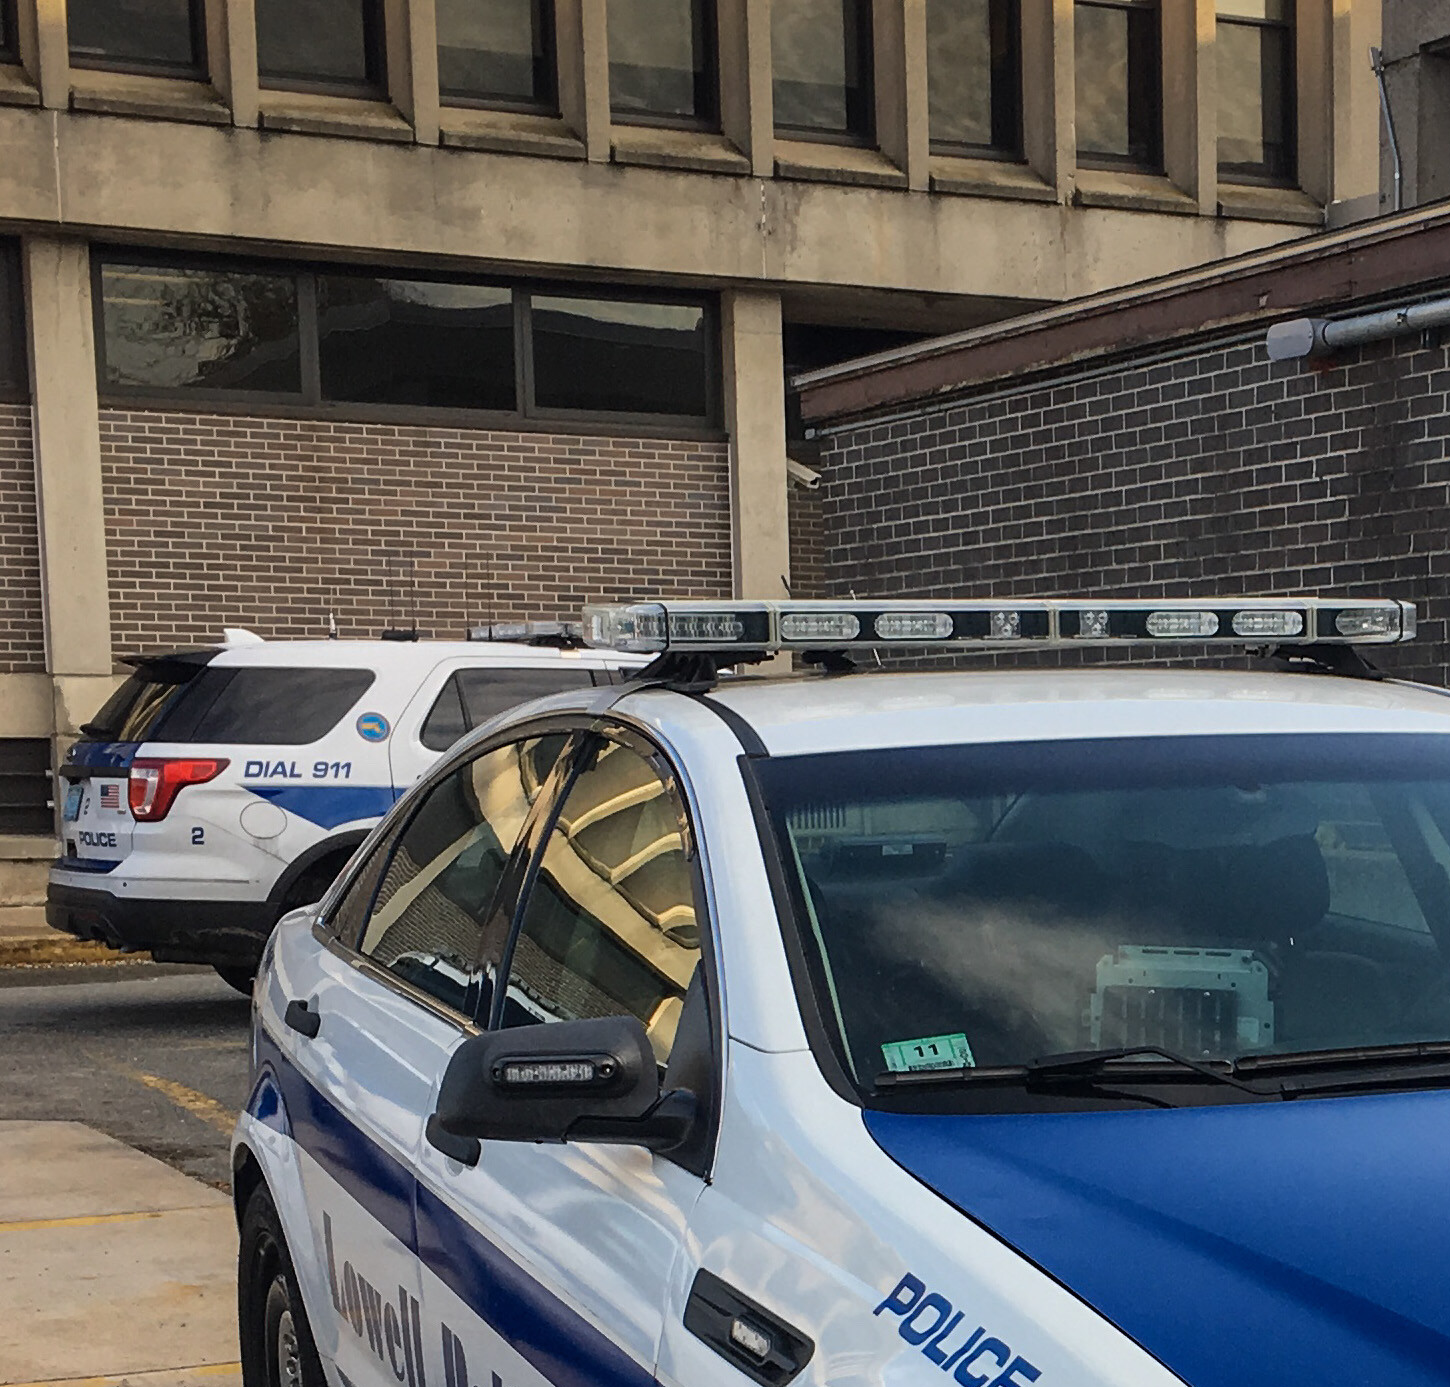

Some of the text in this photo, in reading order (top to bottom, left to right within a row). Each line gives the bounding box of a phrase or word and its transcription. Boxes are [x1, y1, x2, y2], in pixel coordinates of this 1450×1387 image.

[244, 760, 352, 779] DIAL 911
[78, 831, 118, 848] POLICE
[191, 827, 205, 845] 2
[913, 1044, 939, 1058] 11
